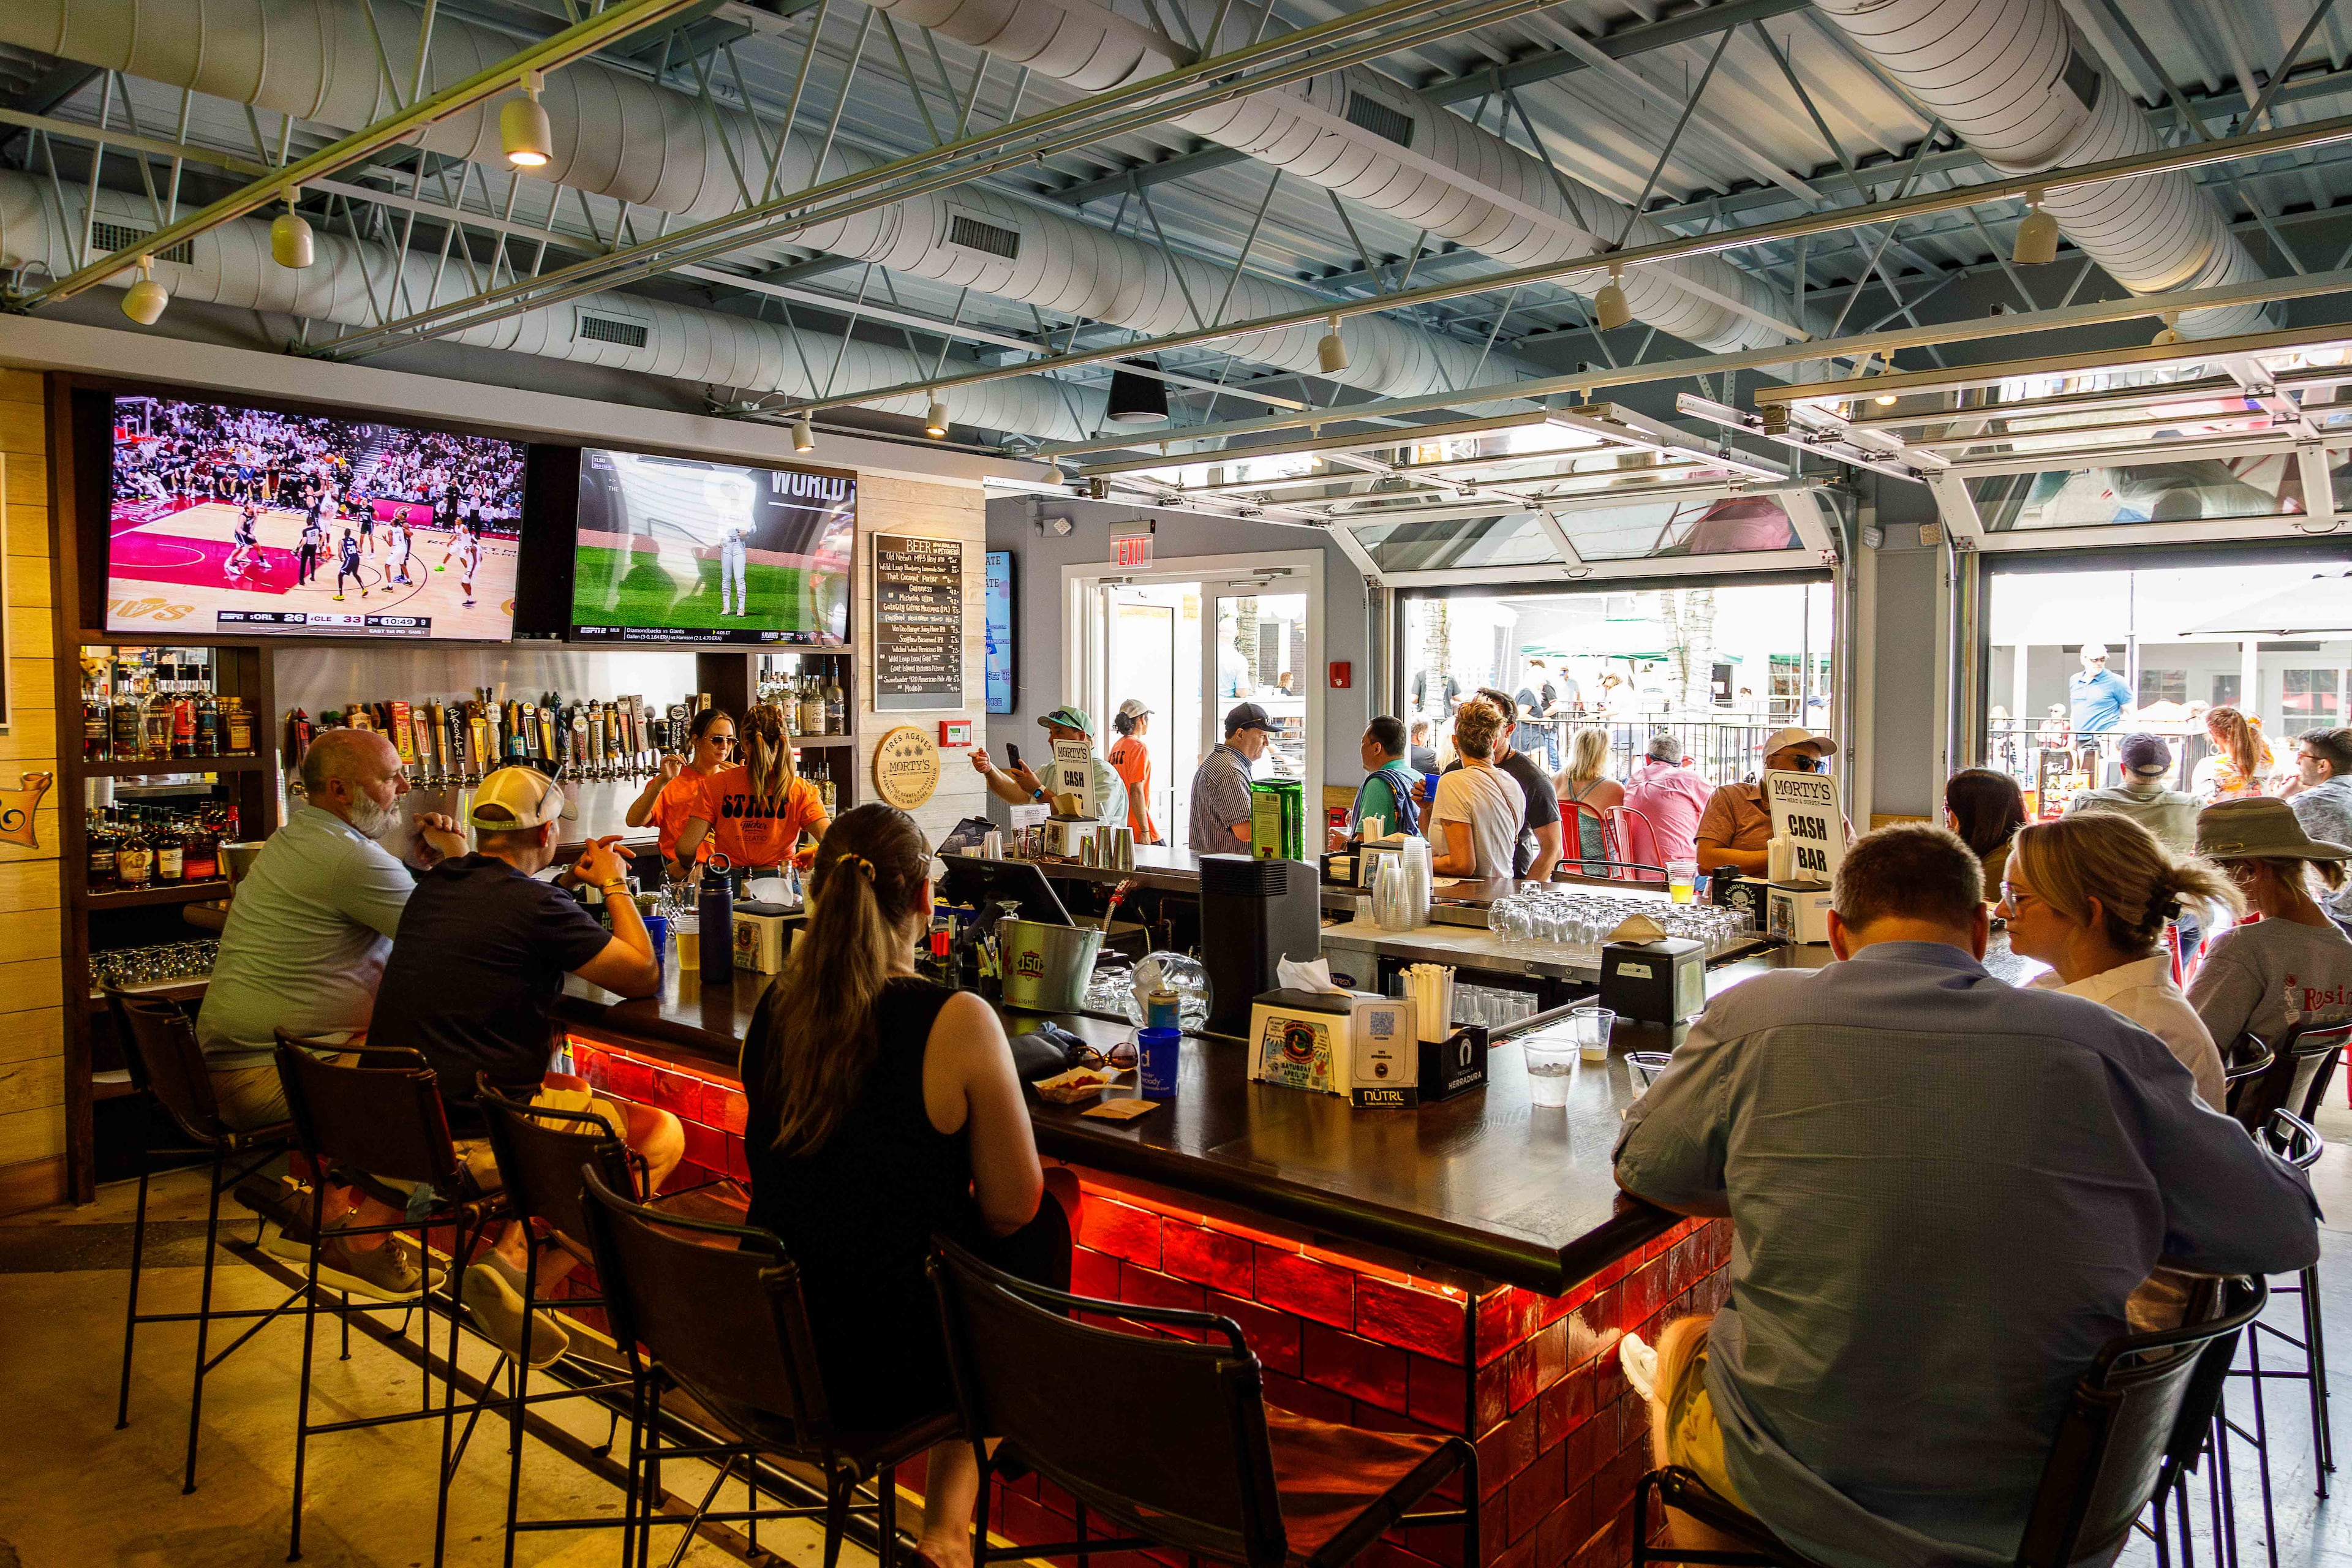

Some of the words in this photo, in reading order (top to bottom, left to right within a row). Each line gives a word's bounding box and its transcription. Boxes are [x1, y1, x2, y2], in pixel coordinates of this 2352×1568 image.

[772, 472, 846, 501] WORLD
[907, 539, 932, 553] BEER
[1118, 537, 1147, 565] EXIT
[896, 552, 912, 561] Nation
[986, 556, 1001, 565] ATE
[892, 563, 903, 572] Leap
[900, 573, 920, 582] Coconut
[909, 584, 932, 593] Guinness
[899, 594, 920, 602] Michelob
[906, 603, 921, 612] Citrus
[899, 635, 918, 644] Scofflaw
[905, 684, 922, 693] Modelo
[885, 734, 902, 753] TRES
[905, 733, 933, 751] AGAVES
[1058, 746, 1087, 760] MORTY'S
[889, 760, 930, 772] MORTY'S
[1064, 770, 1085, 787] CASH
[883, 771, 893, 795] ORGANIC
[914, 791, 929, 803] AGAVE
[1774, 779, 1831, 800] MORTY'S
[740, 820, 767, 831] Tucker
[1788, 814, 1827, 841] CASH
[1796, 846, 1828, 872] BAR
[1725, 884, 1755, 899] KURVBALL
[1020, 956, 1040, 972] 150
[1281, 1062, 1311, 1072] SATURDAY
[1448, 1072, 1483, 1090] HERRADURA
[1364, 1088, 1404, 1101] NÜTRL
